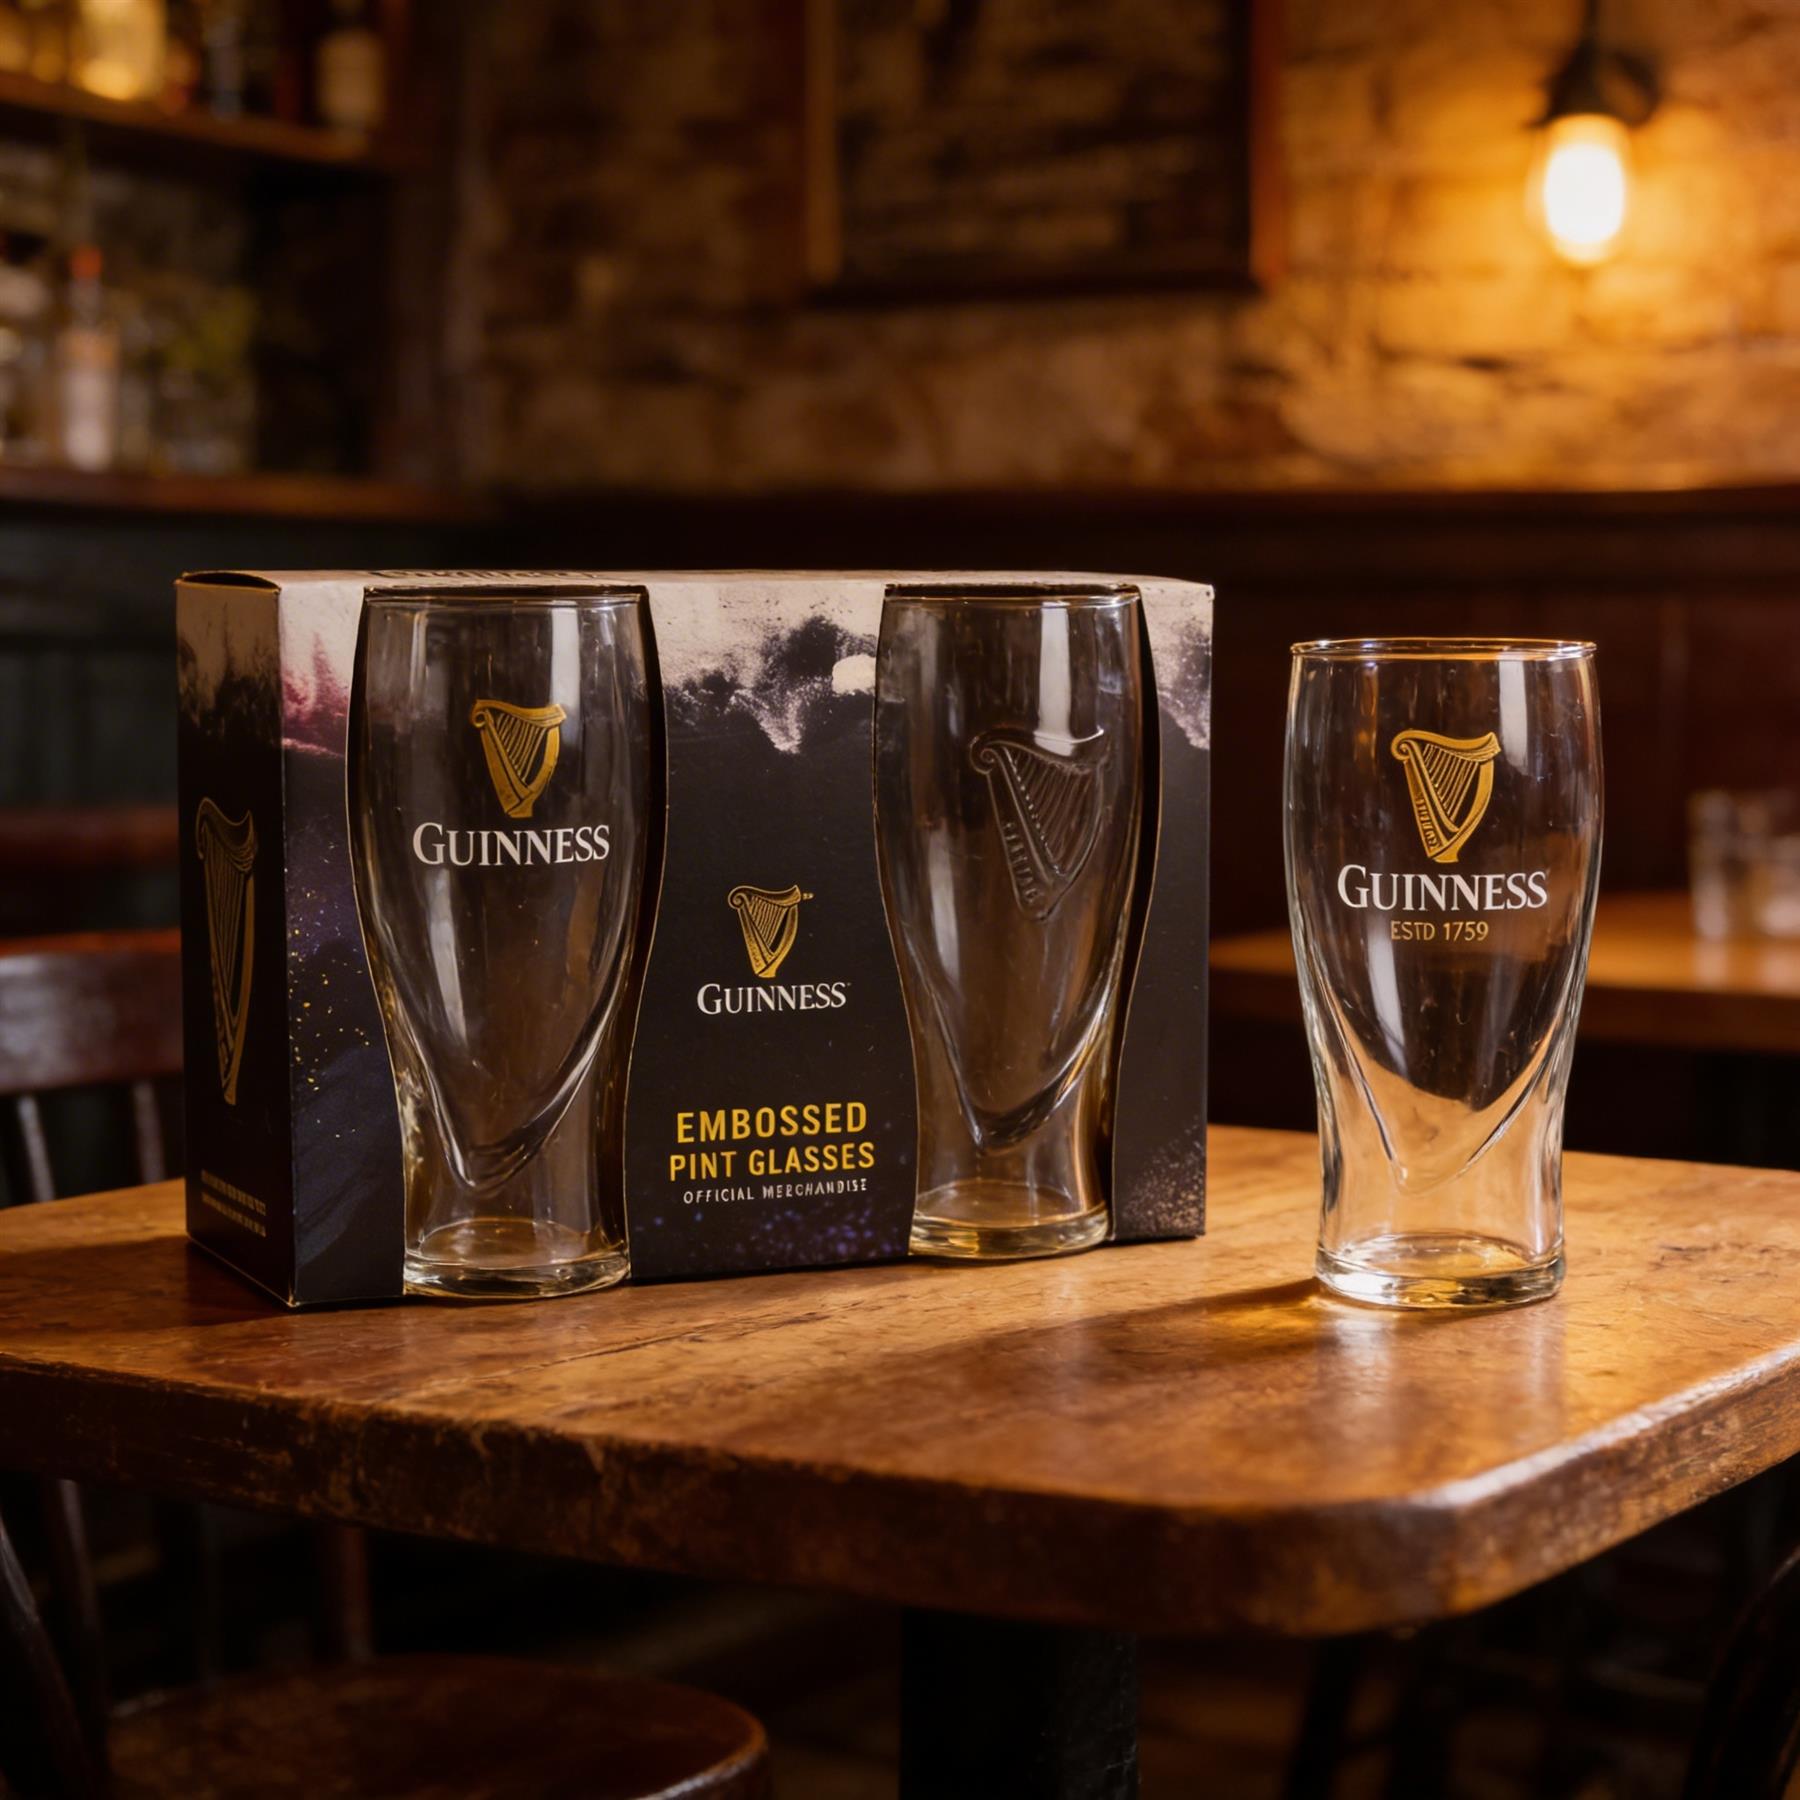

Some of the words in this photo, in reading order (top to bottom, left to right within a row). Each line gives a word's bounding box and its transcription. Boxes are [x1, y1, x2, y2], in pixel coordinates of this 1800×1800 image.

[412, 821, 611, 866] GUINNESS
[1337, 864, 1548, 911] GUINNESS
[1390, 920, 1436, 941] ESTD
[1443, 920, 1489, 942] 1759
[697, 982, 847, 1015] GUINNESS
[677, 1102, 867, 1143] EMBOSSED
[670, 1151, 737, 1181] PINT
[749, 1142, 875, 1175] GLASSES
[683, 1186, 755, 1205] OFFICIAL
[763, 1178, 867, 1199] MERCHANDISE
